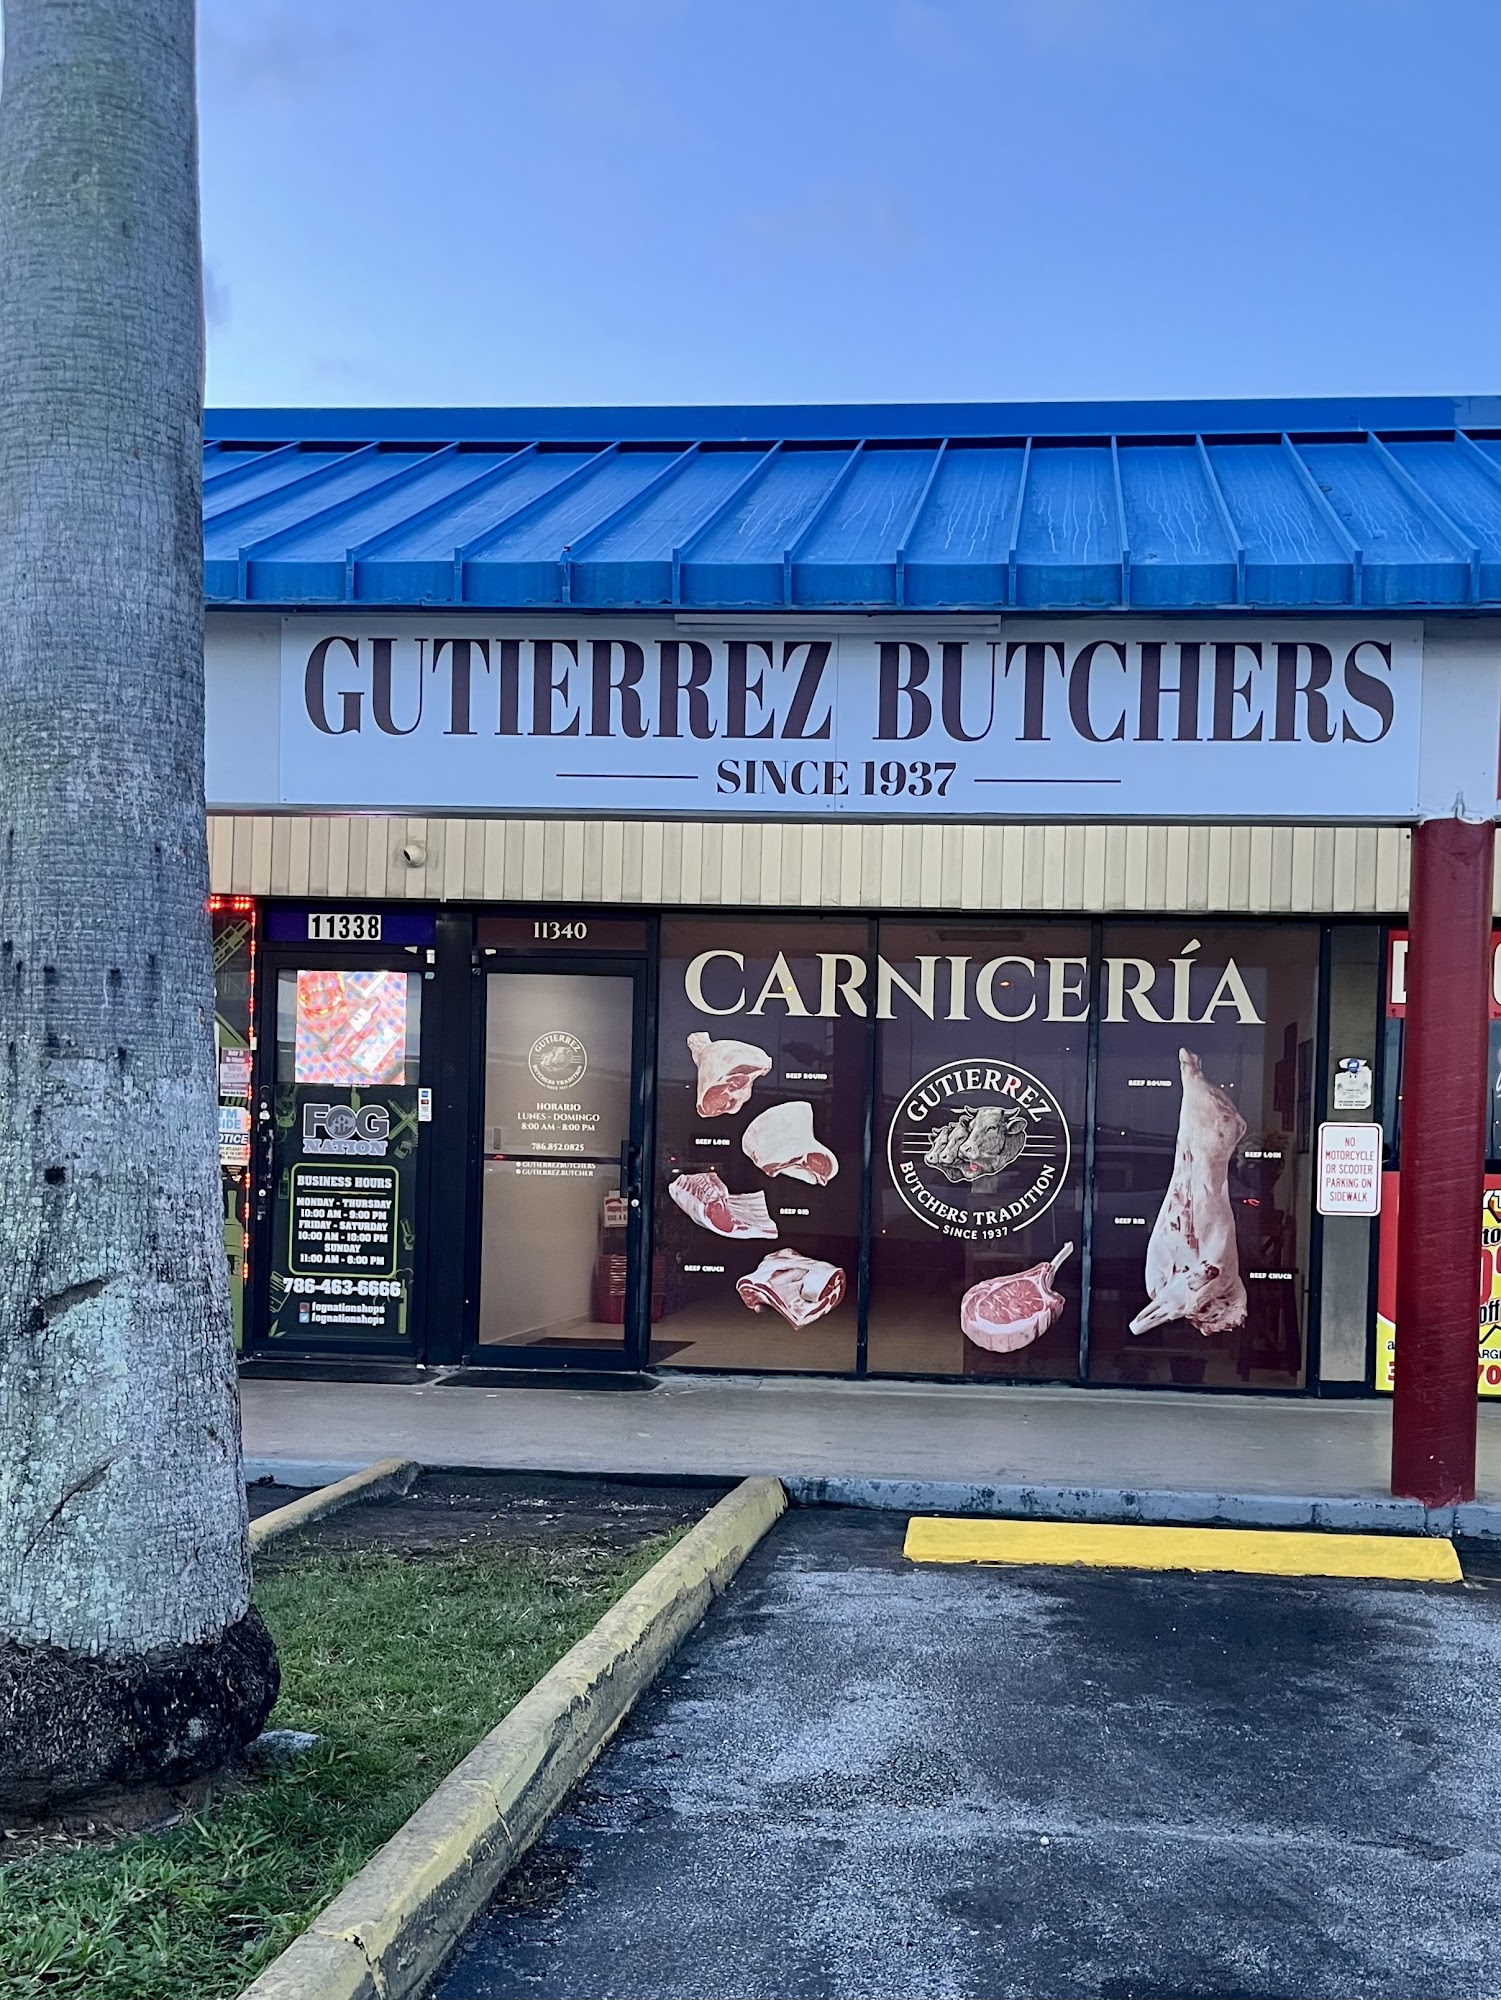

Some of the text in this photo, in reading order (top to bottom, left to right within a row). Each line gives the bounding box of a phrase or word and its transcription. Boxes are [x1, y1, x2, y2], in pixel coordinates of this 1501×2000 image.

[304, 635, 1394, 744] GUTIERREZ BUTCHERS
[716, 759, 957, 796] SINCE 1937
[311, 915, 379, 938] 11338
[533, 922, 588, 939] 11340
[684, 938, 1266, 1024] CARNICERÍA
[534, 1034, 582, 1053] GUTIERREZ
[907, 1068, 1052, 1122] GUTIERREZ
[536, 1103, 582, 1112] HORARIO
[303, 1103, 390, 1140] FOG
[517, 1112, 547, 1120] LUNES
[553, 1113, 601, 1122] DOMINGO
[521, 1122, 540, 1130] 8:00
[541, 1123, 556, 1131] AM
[562, 1123, 581, 1132] 8:00
[582, 1124, 596, 1132] PM
[302, 1138, 388, 1156] NATION
[531, 1143, 585, 1152] 786.852.0825
[1344, 1136, 1356, 1147] NO
[1325, 1150, 1375, 1161] MOTORCYCLE
[1326, 1163, 1373, 1175] OR SCOOTER
[296, 1175, 392, 1189] BUSINESS HOURS
[1326, 1177, 1372, 1188] PARKING ON
[900, 1160, 1057, 1226] BUTCHERS TRADITION
[1329, 1191, 1368, 1202] SIDEWALK
[296, 1197, 335, 1207] MONDAY
[342, 1199, 392, 1209] THURSDAY
[301, 1208, 326, 1218] 10:00
[326, 1209, 342, 1219] AM
[349, 1210, 371, 1219] 9:00
[372, 1211, 387, 1220] PM
[299, 1220, 332, 1230] FRIDAY
[339, 1221, 389, 1231] SATURDAY
[942, 1224, 1009, 1240] SINCE 1937
[298, 1231, 323, 1240] 10:00
[324, 1232, 340, 1241] AM
[347, 1233, 372, 1242] 10:00
[373, 1233, 389, 1243] PM
[324, 1244, 362, 1253] SUNDAY
[300, 1253, 323, 1263] 11:00
[324, 1254, 340, 1264] AM
[347, 1256, 369, 1265] 8:00
[370, 1256, 385, 1266] PM
[283, 1278, 402, 1297] 786-463-6666
[311, 1301, 386, 1315] fognationshops
[311, 1312, 385, 1326] fognationshops
